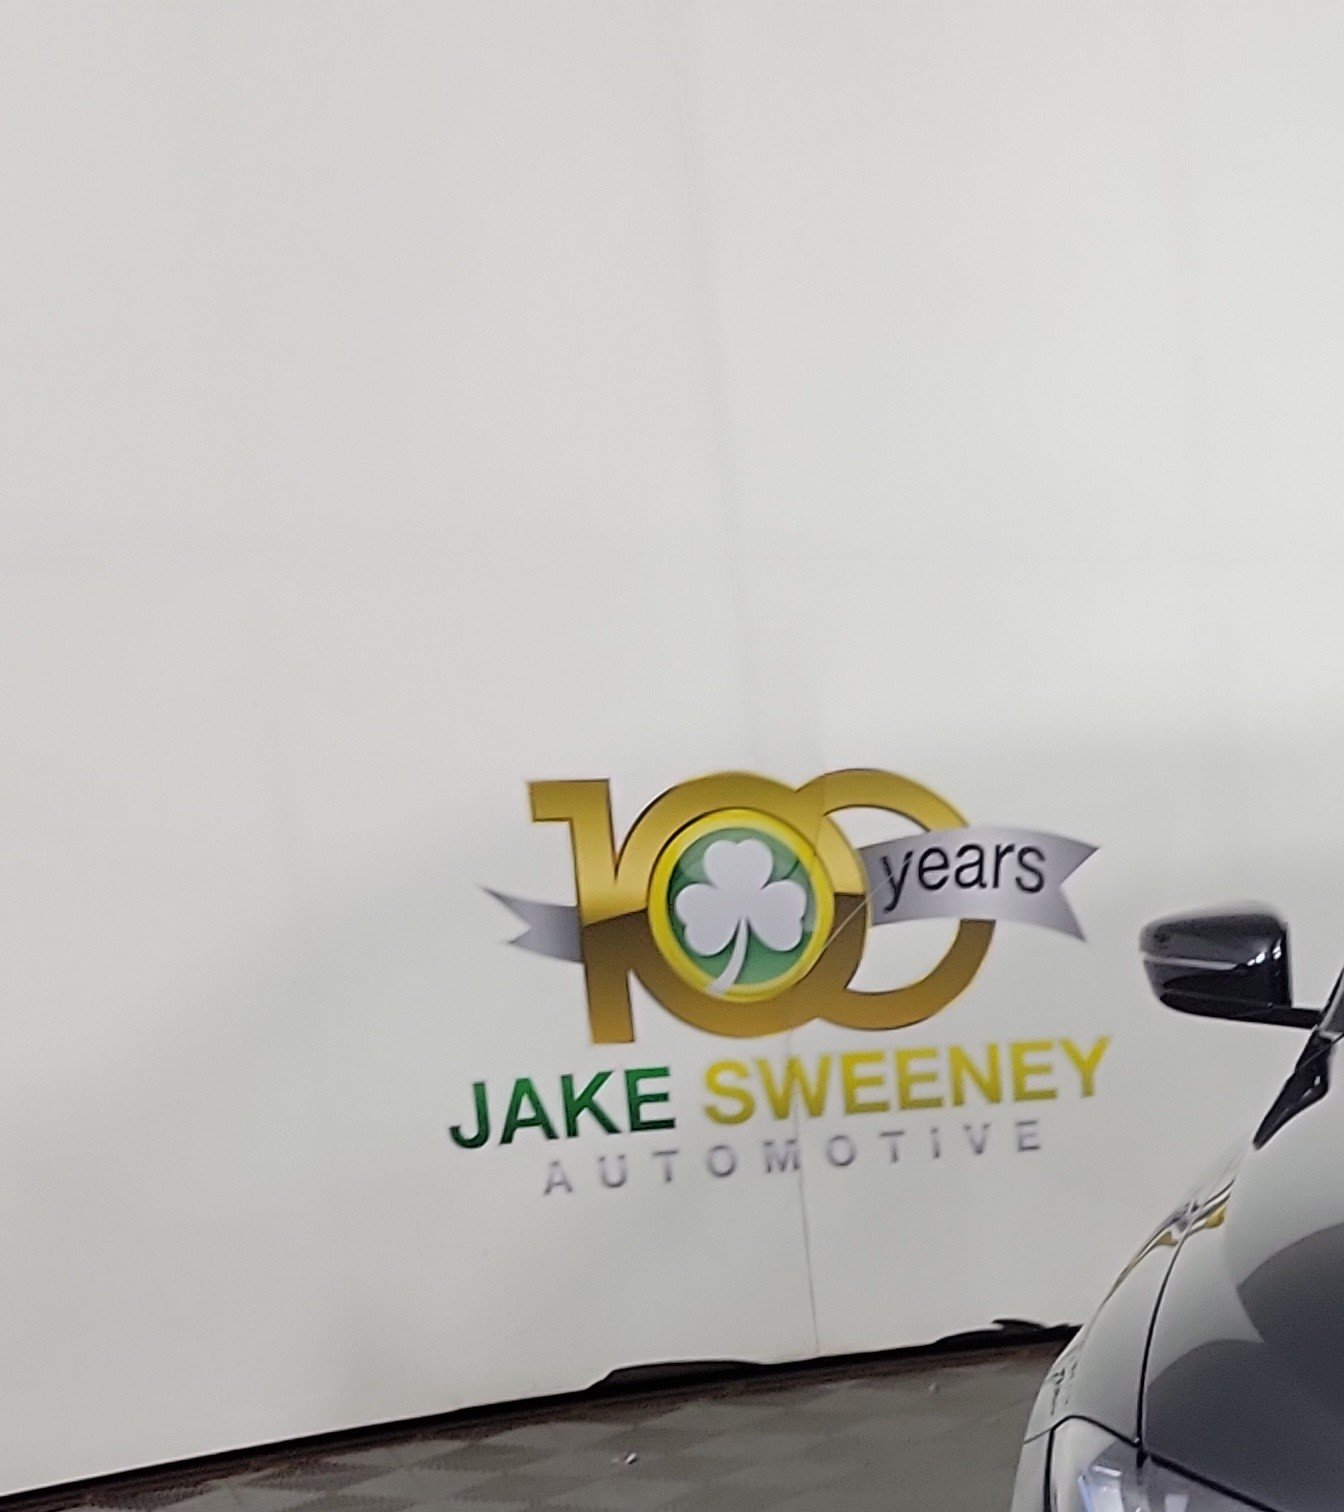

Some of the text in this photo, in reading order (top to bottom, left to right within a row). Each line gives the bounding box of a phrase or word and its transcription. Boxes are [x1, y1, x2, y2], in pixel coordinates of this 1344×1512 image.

[527, 768, 996, 1044] 100
[881, 842, 1047, 911] years
[449, 1036, 1112, 1149] JAKE SWEENEY
[544, 1120, 1042, 1197] AUTOMOTIVE
